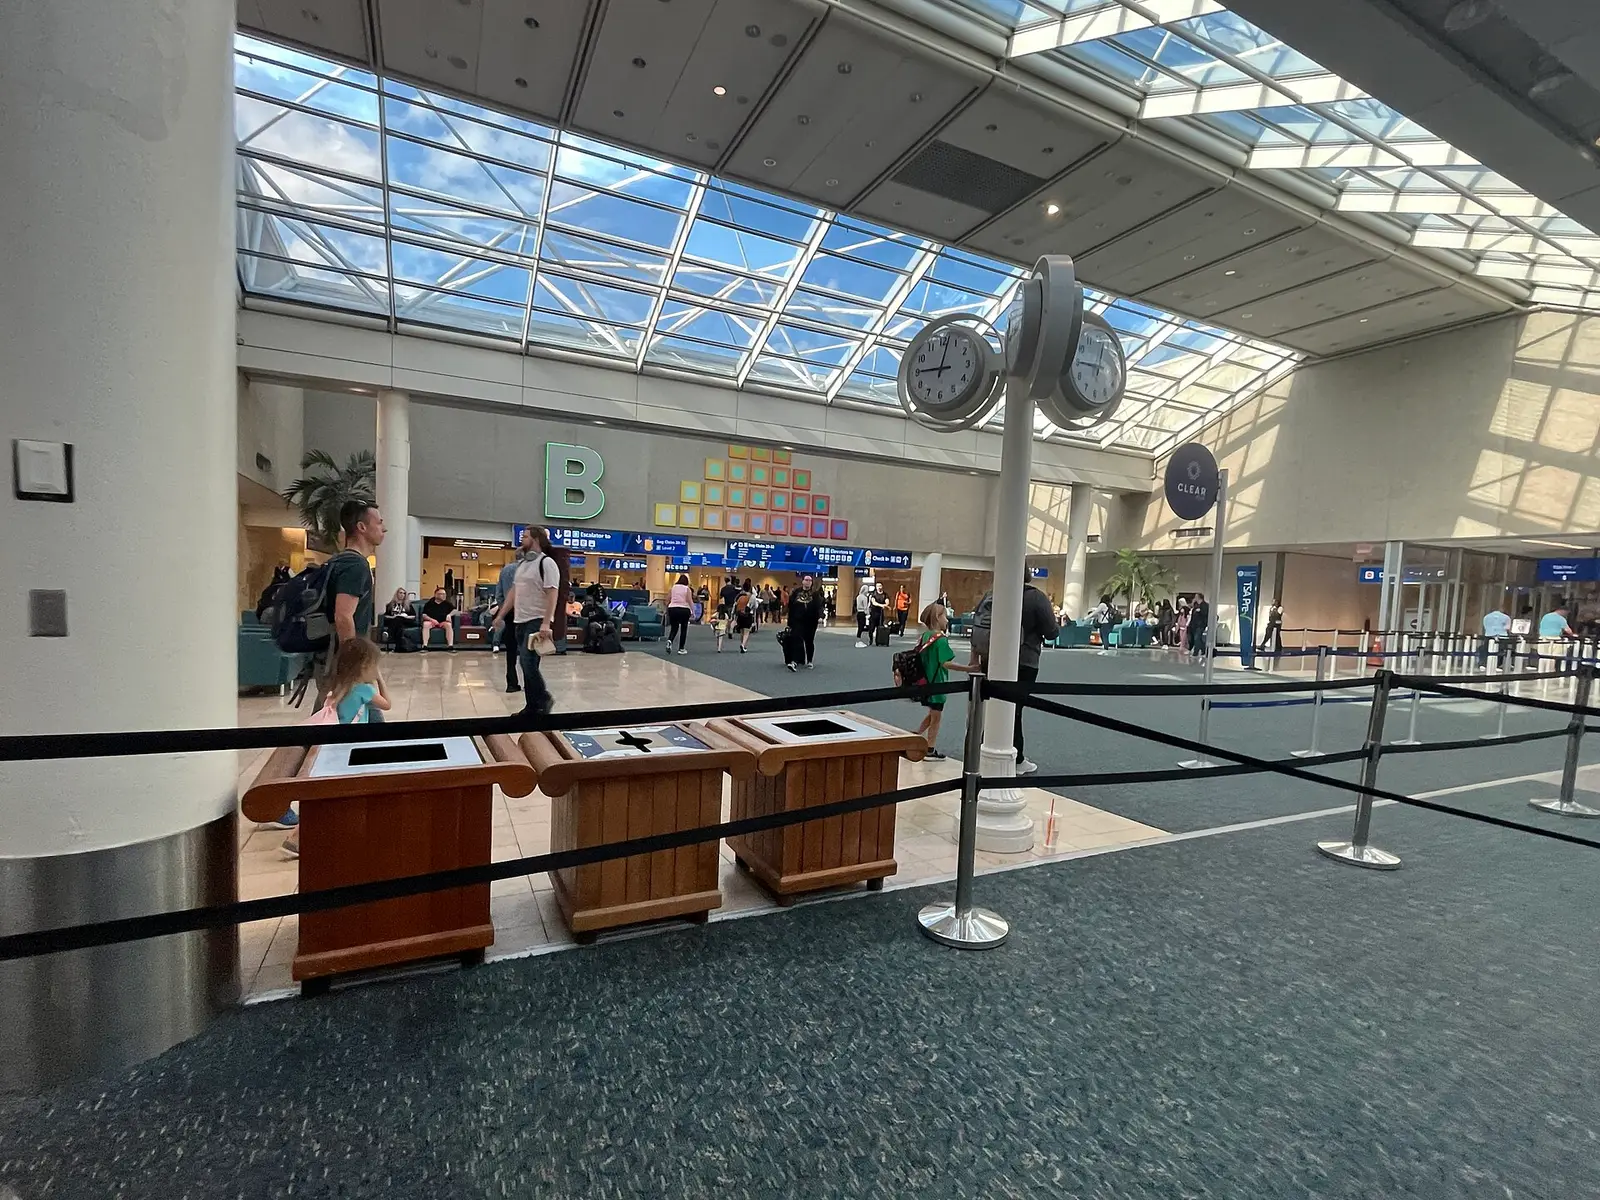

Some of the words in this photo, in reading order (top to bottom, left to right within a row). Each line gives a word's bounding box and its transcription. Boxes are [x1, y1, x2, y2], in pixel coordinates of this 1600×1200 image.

[928, 341, 935, 352] 11
[962, 347, 968, 356] 2
[918, 354, 926, 363] 10
[965, 359, 971, 369] 3
[915, 368, 921, 377] 9
[961, 373, 966, 382] 4
[926, 388, 932, 397] 7
[951, 384, 956, 393] 5
[937, 390, 943, 400] 6
[544, 441, 605, 520] B
[1177, 482, 1207, 497] CLEAR
[580, 531, 604, 539] Escalator
[1243, 581, 1253, 597] TSA
